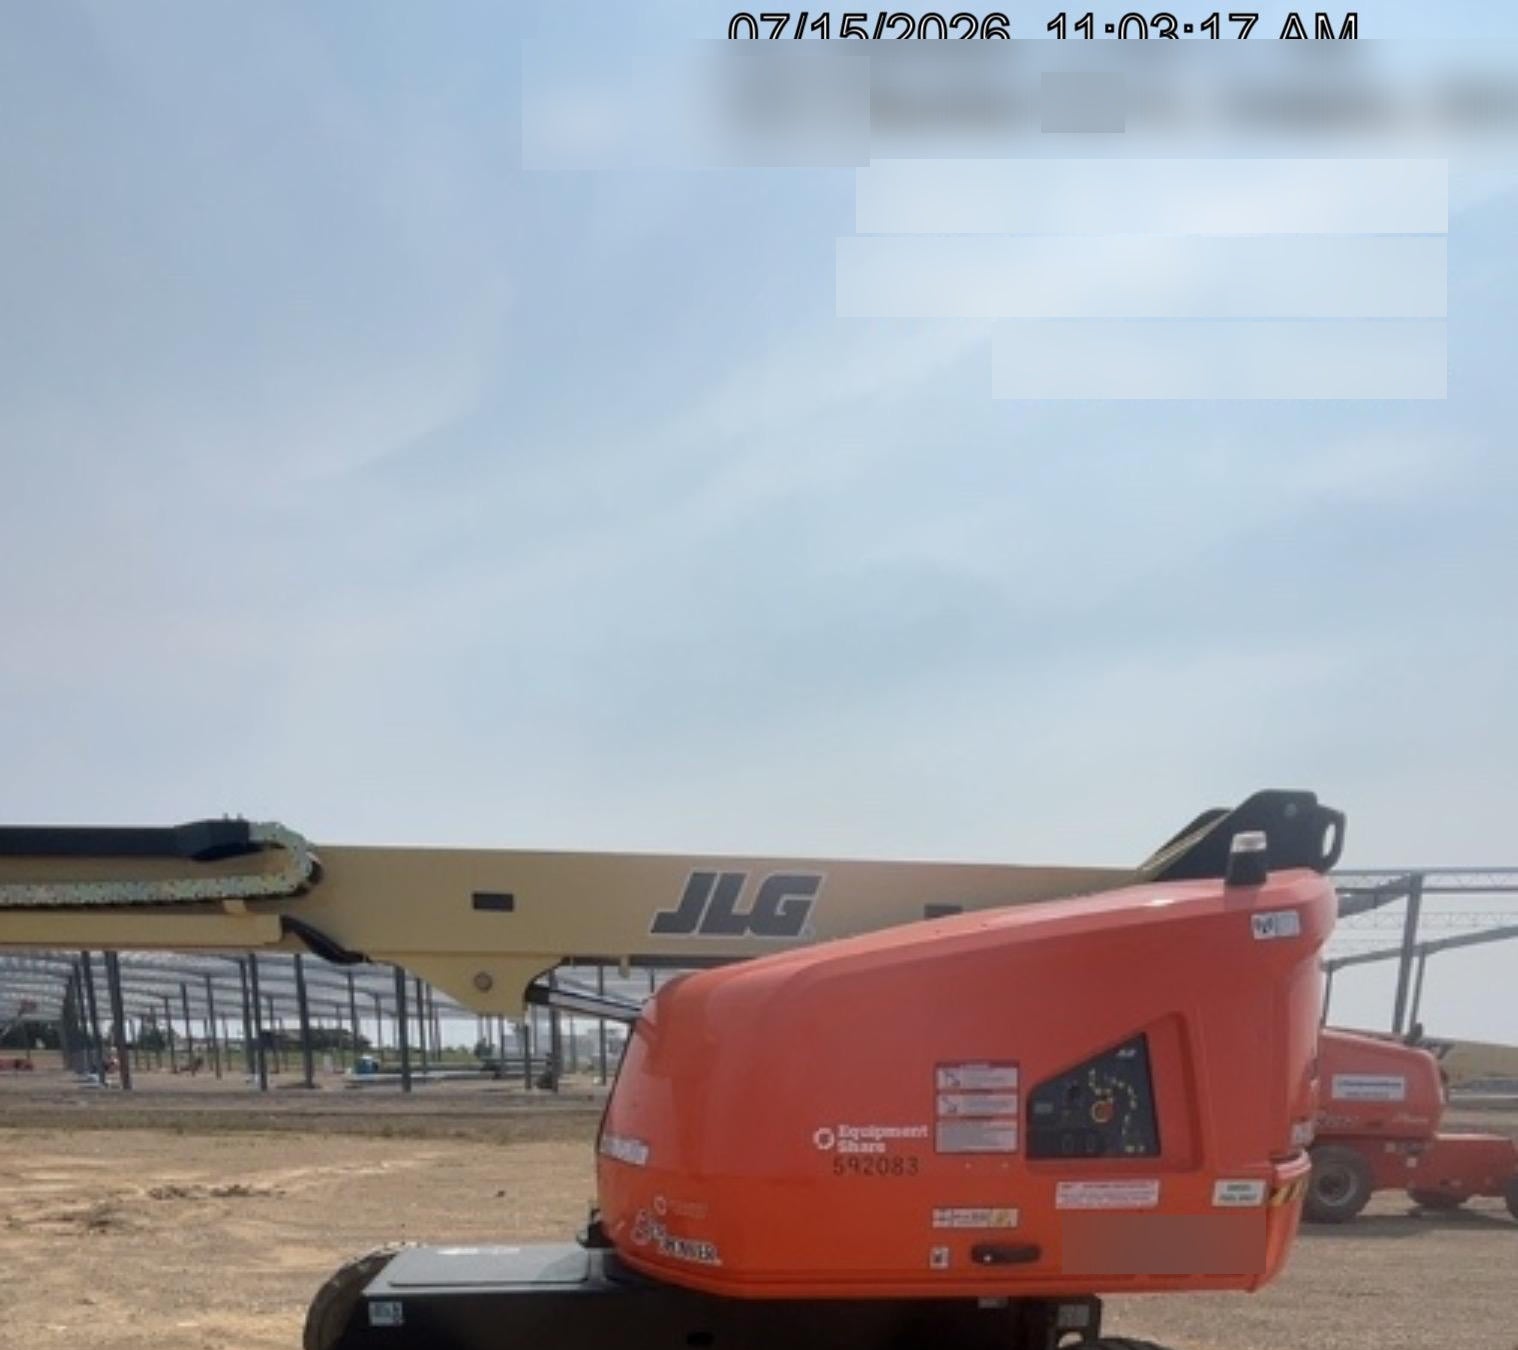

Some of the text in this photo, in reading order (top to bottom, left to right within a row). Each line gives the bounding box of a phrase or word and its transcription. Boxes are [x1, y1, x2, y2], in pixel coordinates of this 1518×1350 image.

[650, 868, 824, 938] JLG
[837, 1124, 928, 1141] Equipment
[837, 1140, 886, 1153] Share
[832, 1155, 920, 1176] 592083
